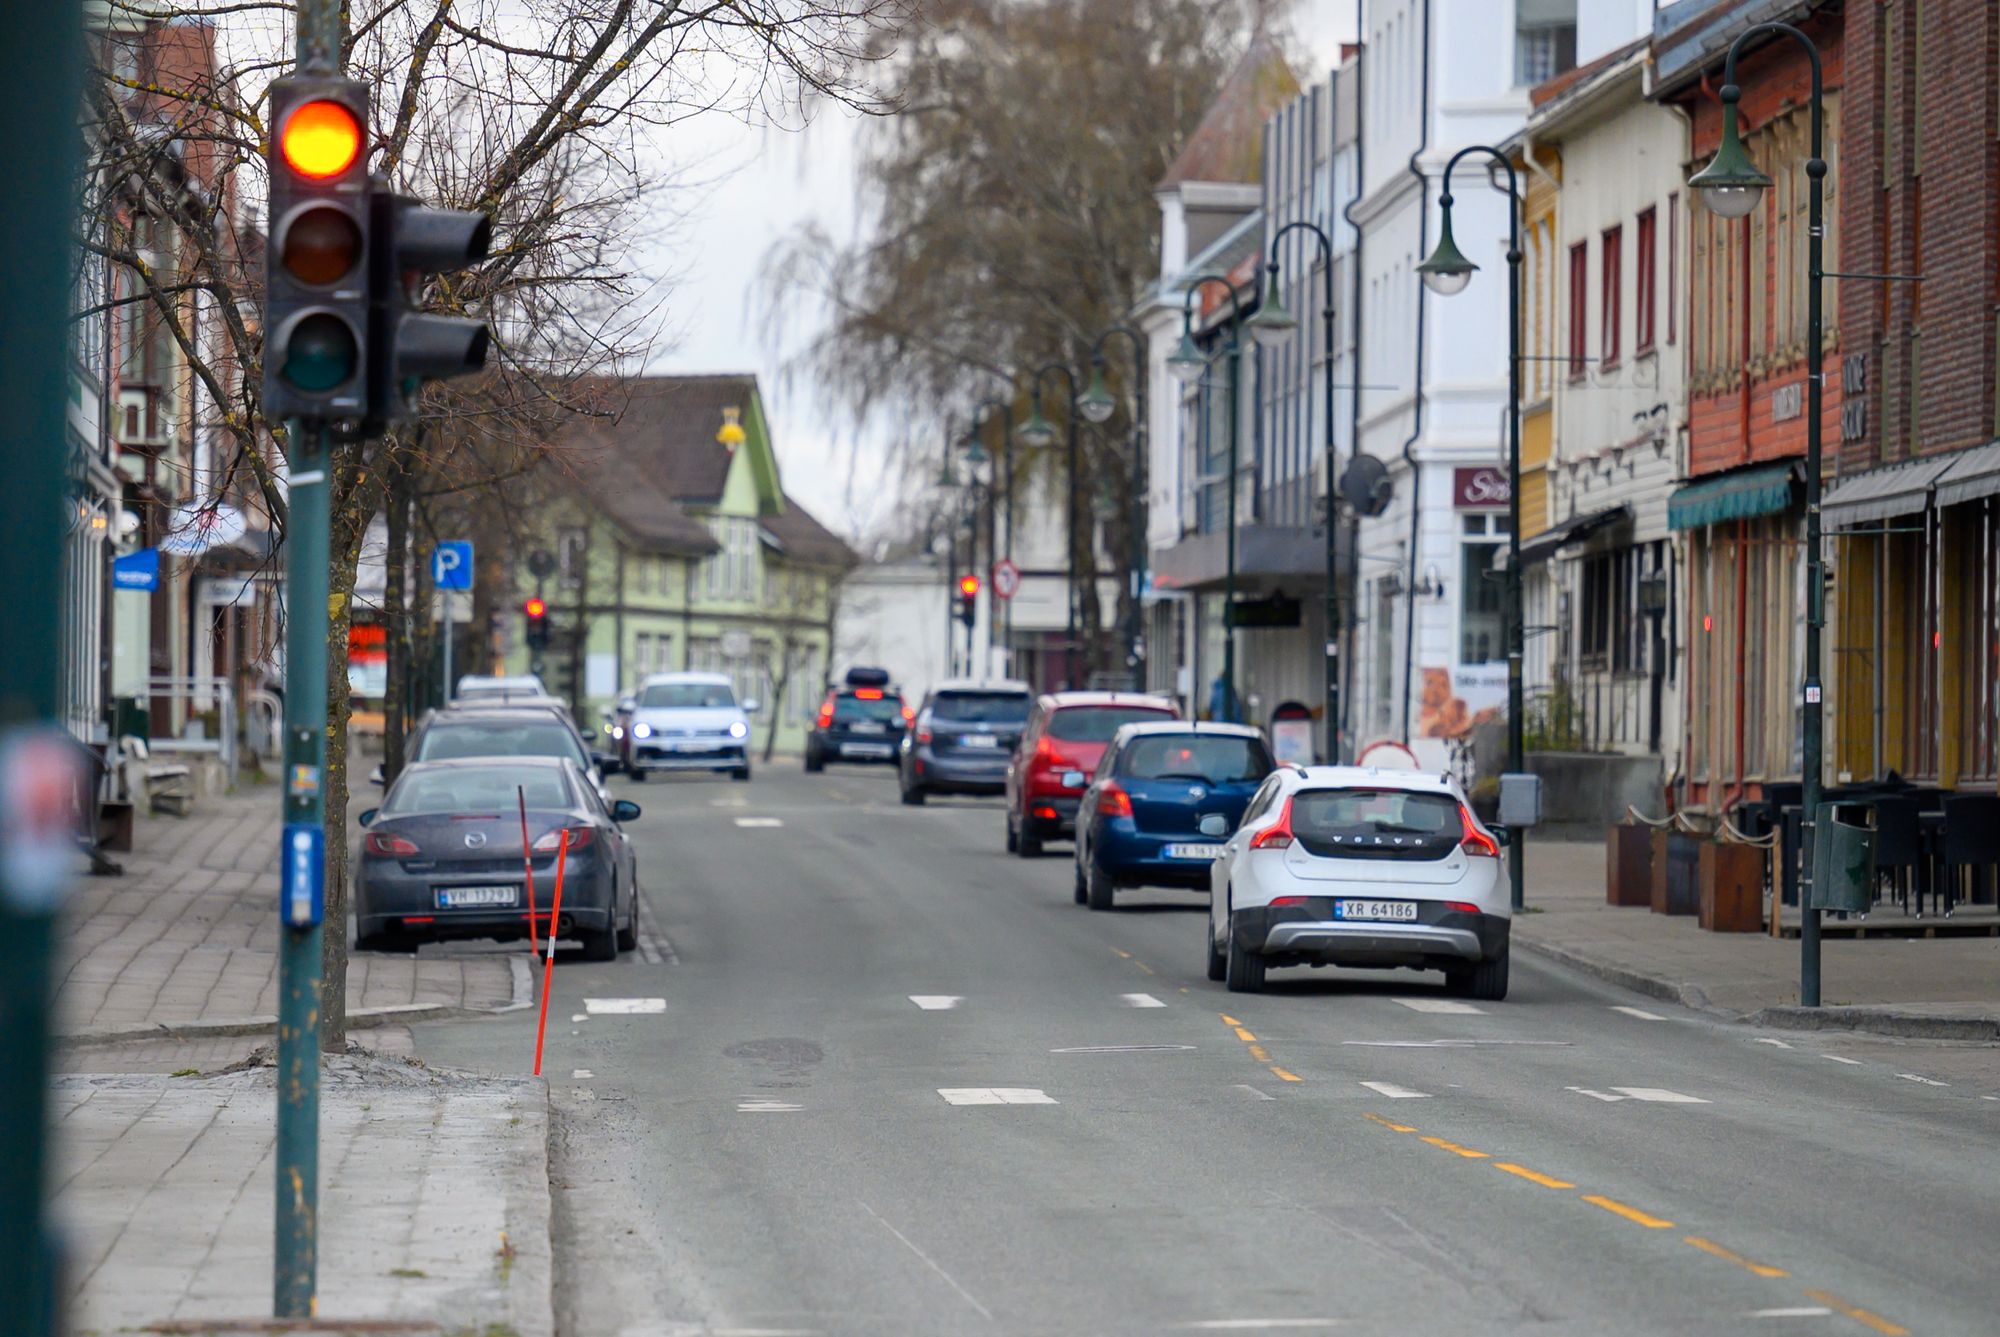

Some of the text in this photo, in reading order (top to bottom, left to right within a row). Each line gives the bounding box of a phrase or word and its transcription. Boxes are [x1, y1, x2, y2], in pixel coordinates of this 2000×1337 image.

[436, 549, 460, 583] P
[1332, 835, 1423, 845] VOLVO
[1346, 902, 1413, 917] XR 64186
